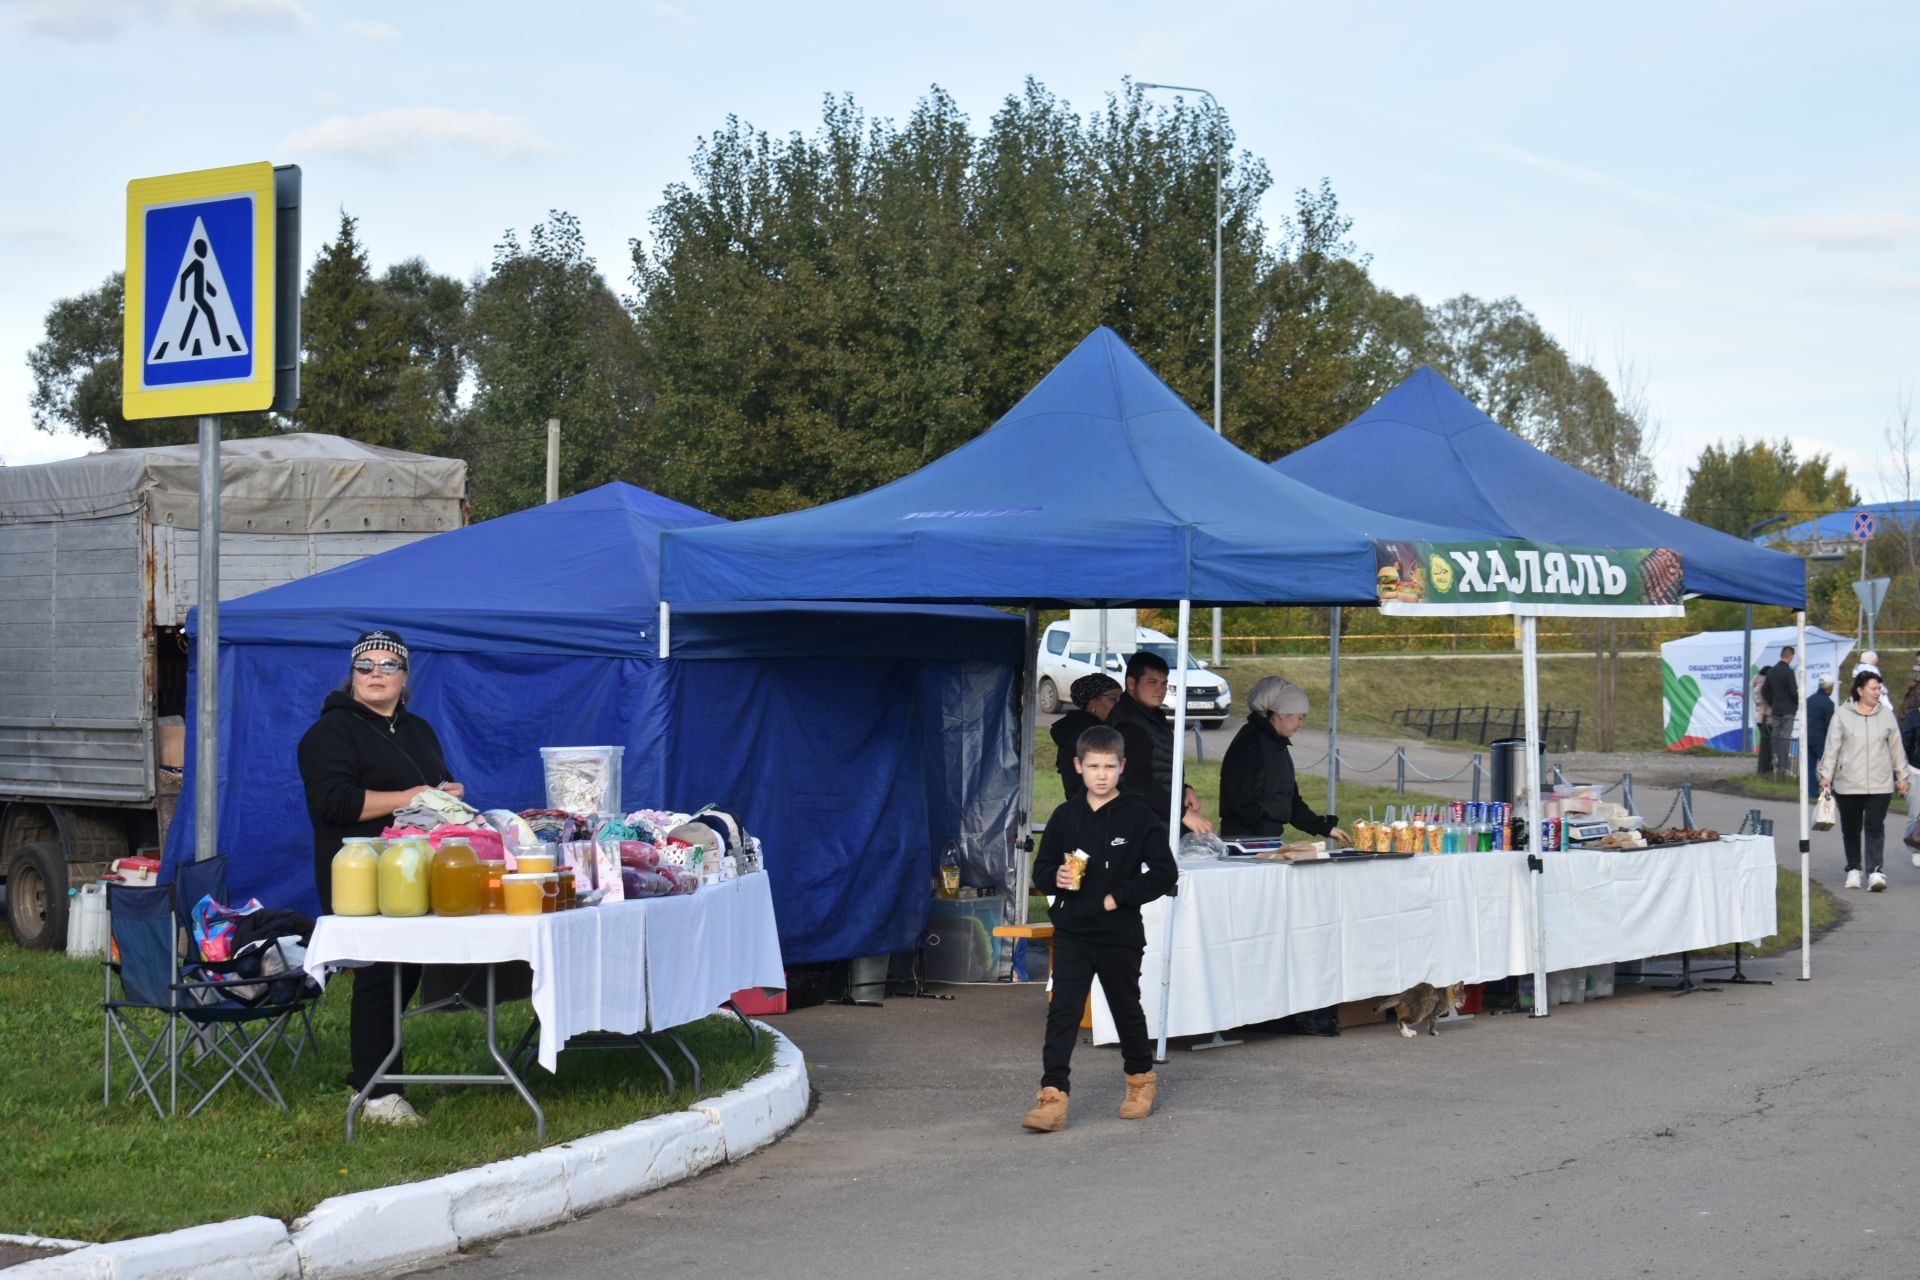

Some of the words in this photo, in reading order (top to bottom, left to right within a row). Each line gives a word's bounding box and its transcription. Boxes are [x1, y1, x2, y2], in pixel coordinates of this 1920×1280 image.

[1449, 550, 1628, 596] ХАЛЯЛЬ
[1688, 664, 1742, 672] ОБЩЕСТВЕННОЙ
[1701, 672, 1743, 680] ПОДДЕРЖКИ
[1548, 823, 1556, 849] NITRO
